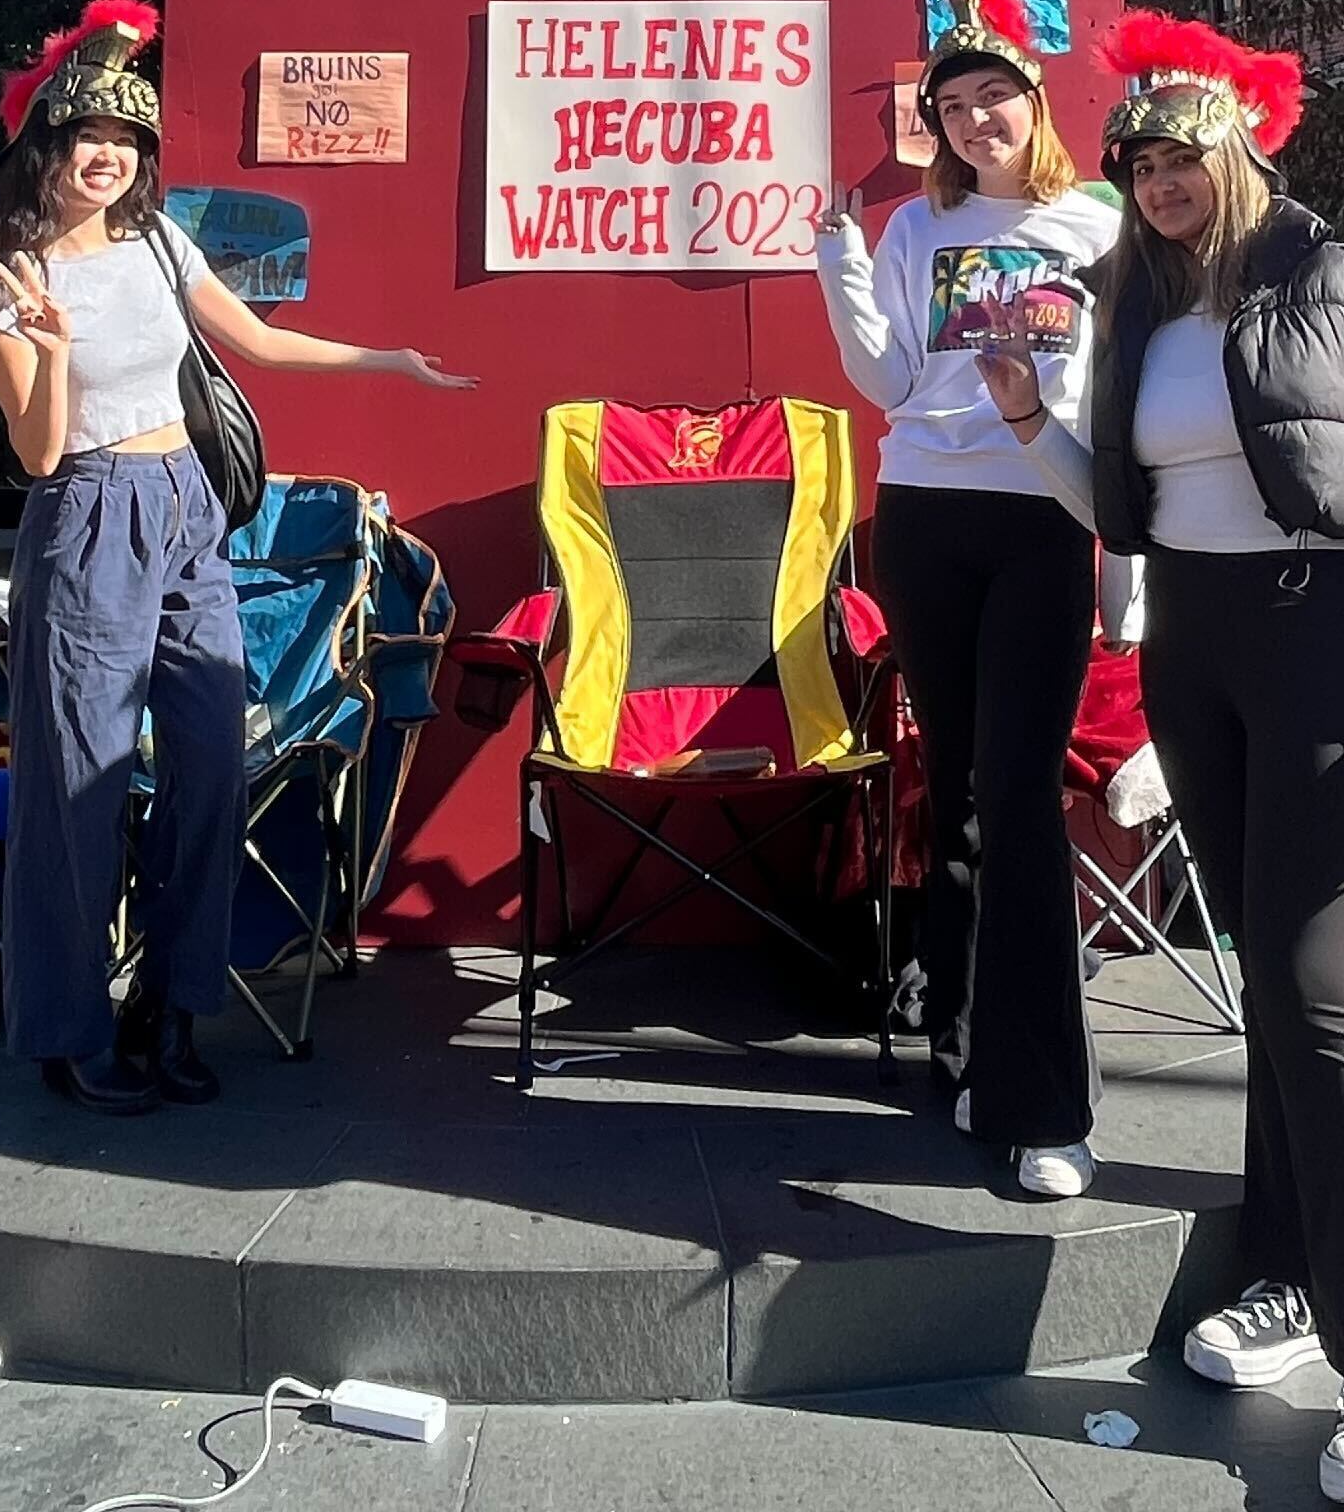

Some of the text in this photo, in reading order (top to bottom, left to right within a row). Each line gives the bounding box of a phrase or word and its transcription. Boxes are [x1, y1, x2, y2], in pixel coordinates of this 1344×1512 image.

[283, 56, 382, 83] BRUINS
[515, 18, 812, 86] HELENES
[554, 99, 773, 172] HECUBA
[500, 181, 824, 259] WATCH 2023
